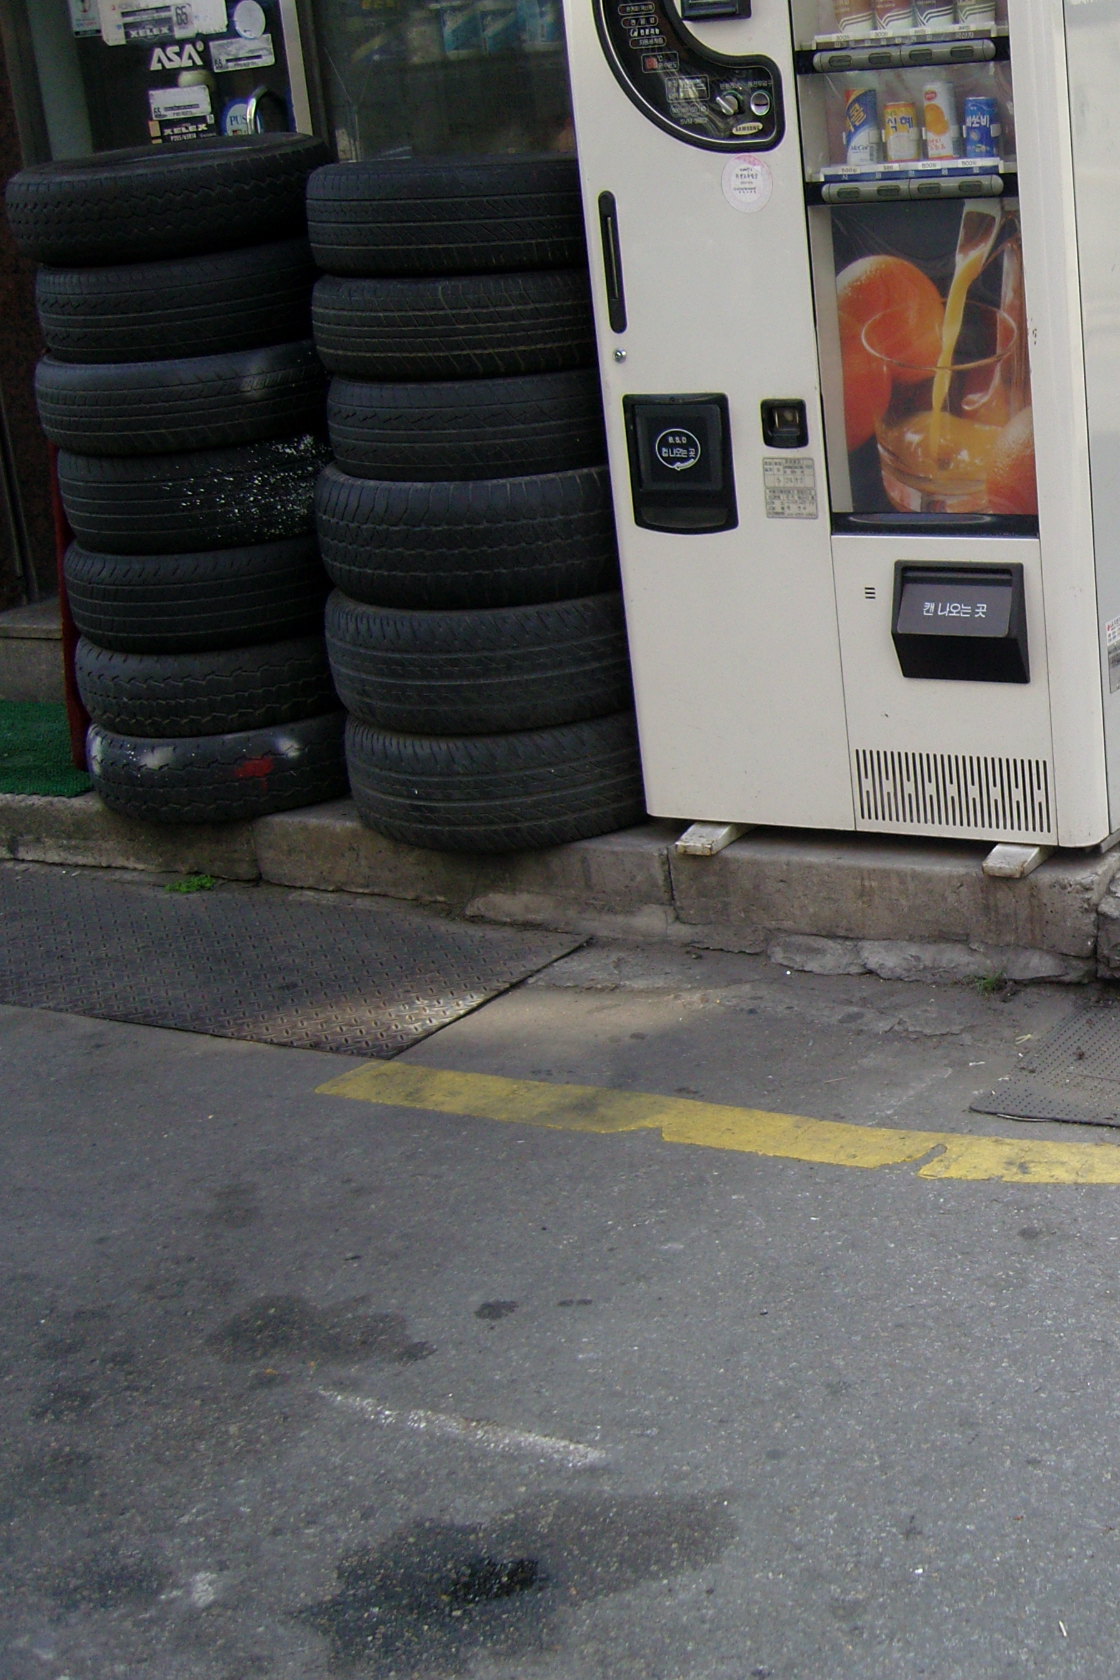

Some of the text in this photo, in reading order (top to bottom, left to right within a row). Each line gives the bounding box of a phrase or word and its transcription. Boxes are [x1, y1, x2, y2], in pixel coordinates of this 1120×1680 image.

[175, 6, 189, 25] 65
[150, 43, 204, 71] ASA
[229, 115, 248, 126] PUS
[886, 116, 914, 132] 식혜
[669, 447, 688, 458] 나오는
[923, 602, 987, 618] 캔 나오는 곳
